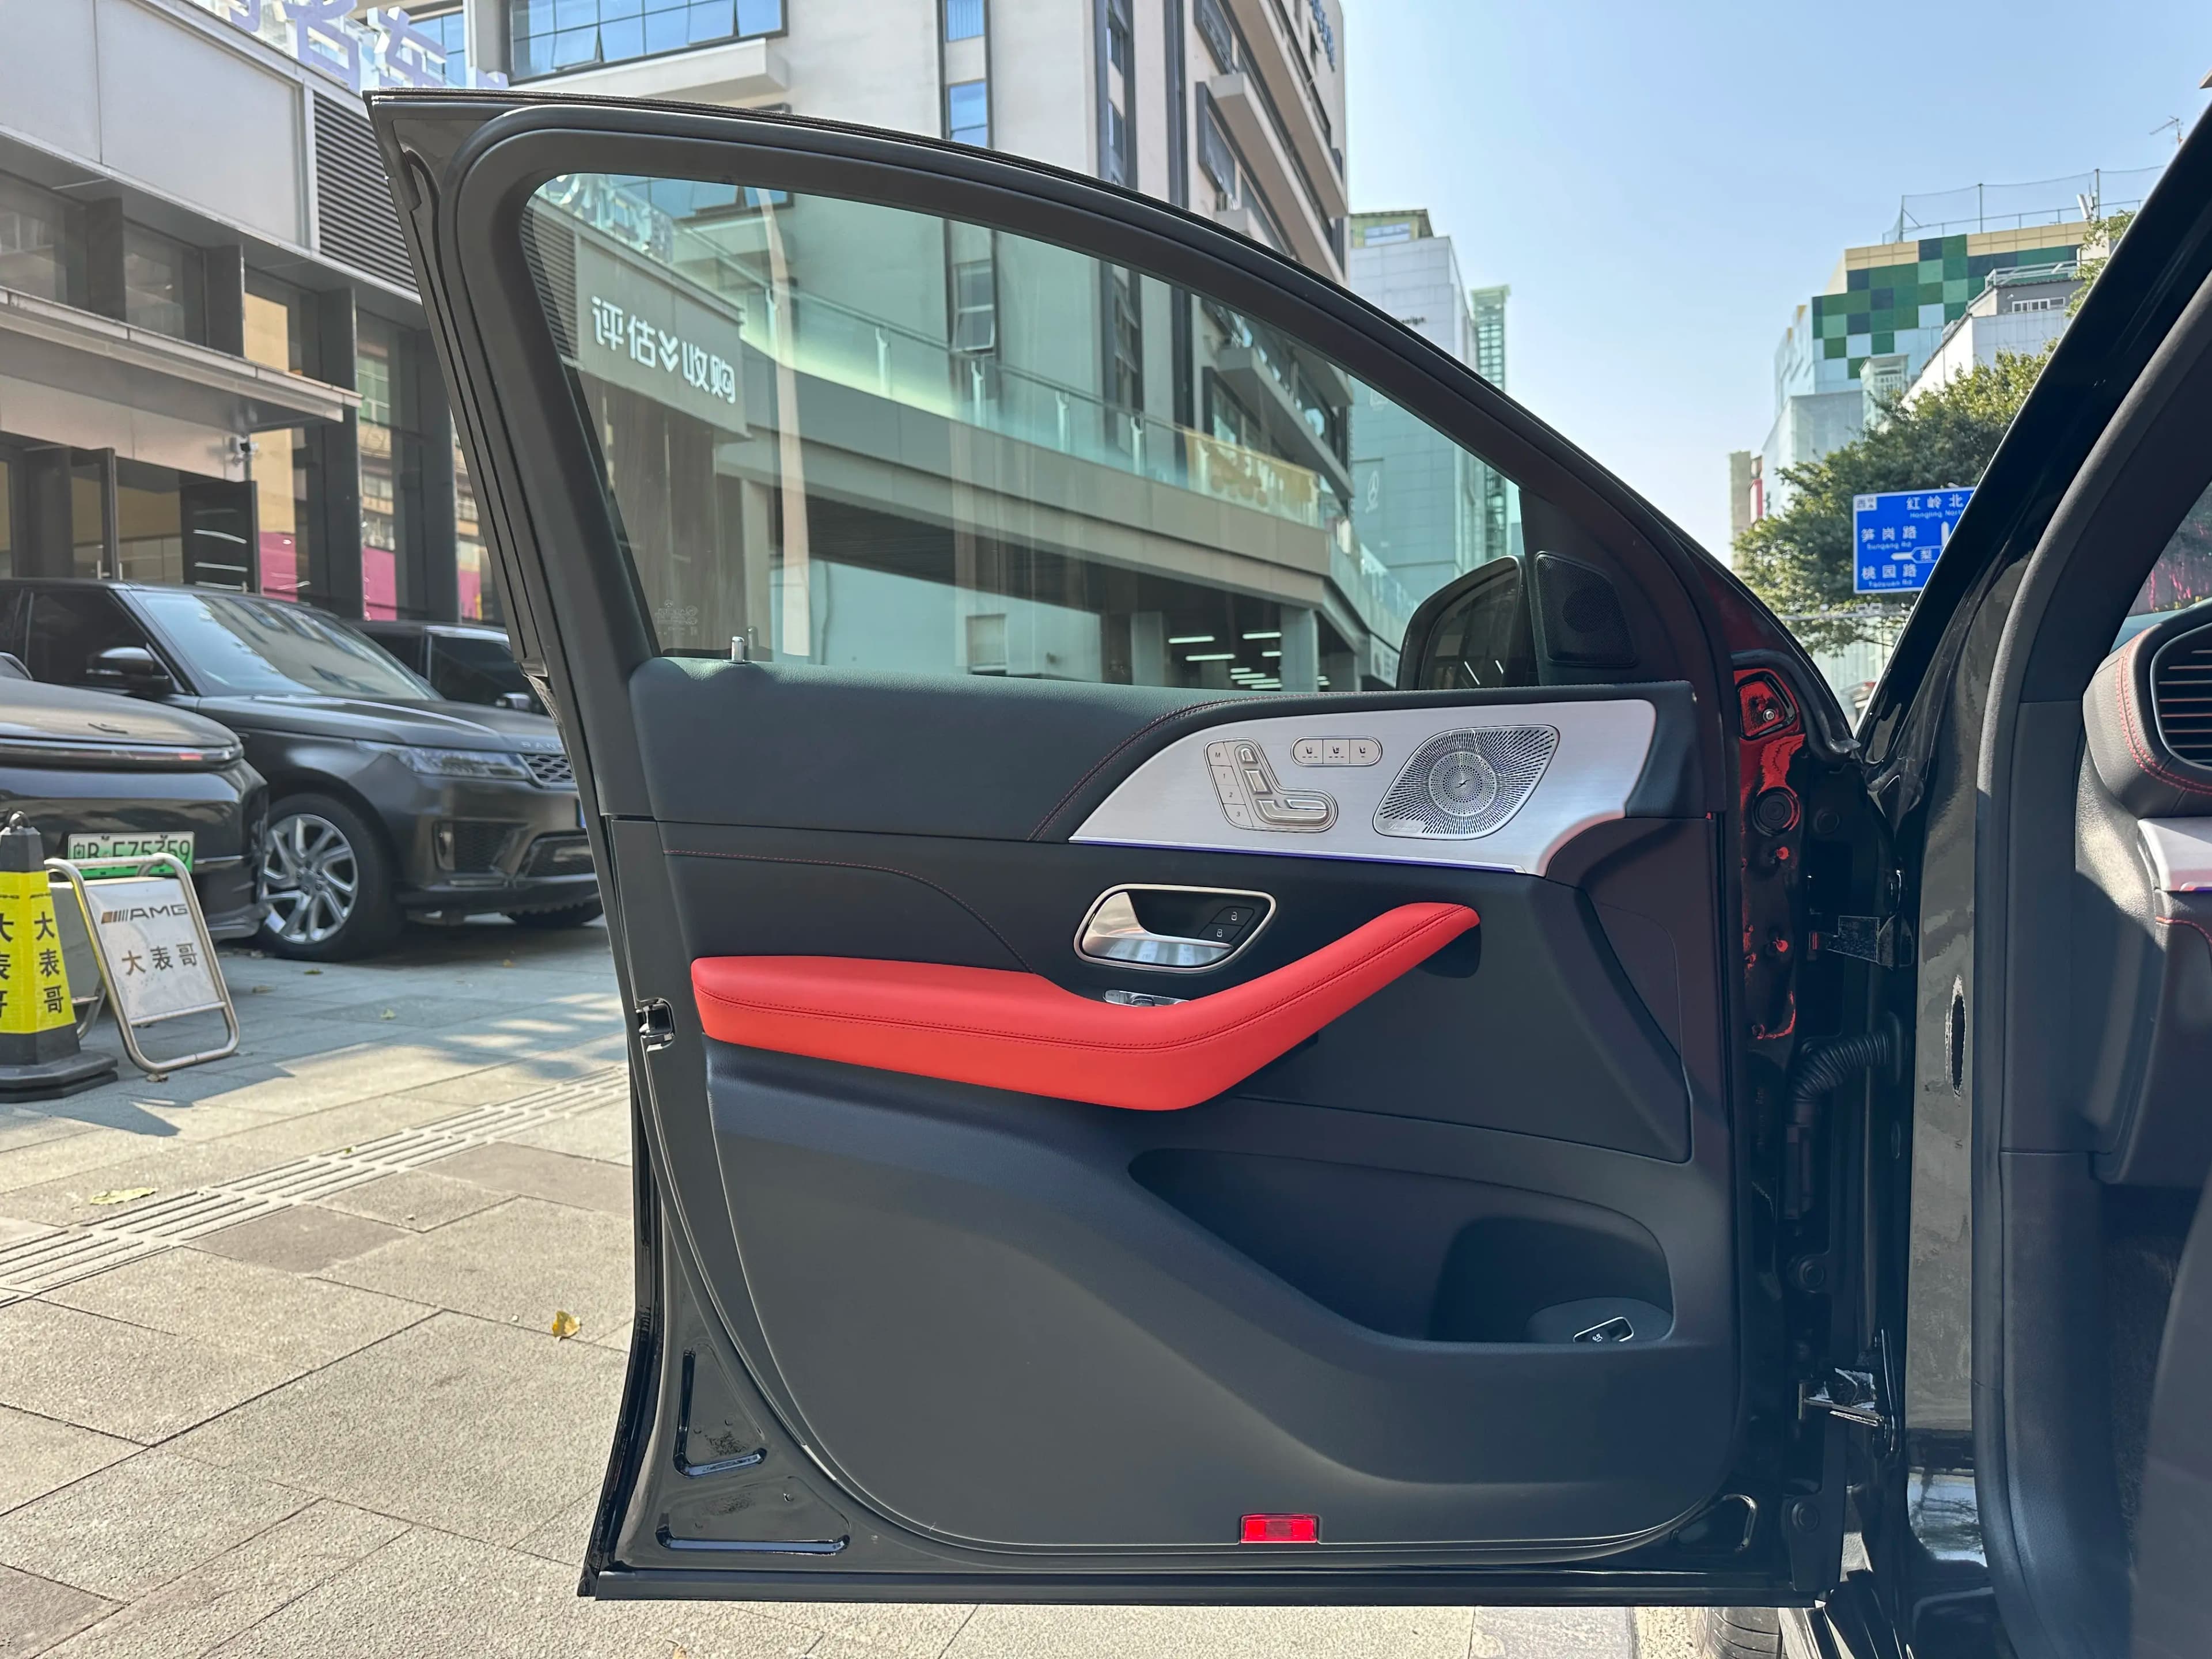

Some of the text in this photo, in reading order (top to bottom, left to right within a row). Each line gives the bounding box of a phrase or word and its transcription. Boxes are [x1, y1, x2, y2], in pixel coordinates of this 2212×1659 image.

[592, 296, 736, 403] 评估 收购
[1906, 494, 1972, 510] 红岭北
[1861, 525, 1917, 543] 笋岗路
[1861, 563, 1917, 581] 桃园路
[34, 911, 63, 1014] 大表哥
[122, 942, 198, 975] 大表哥
